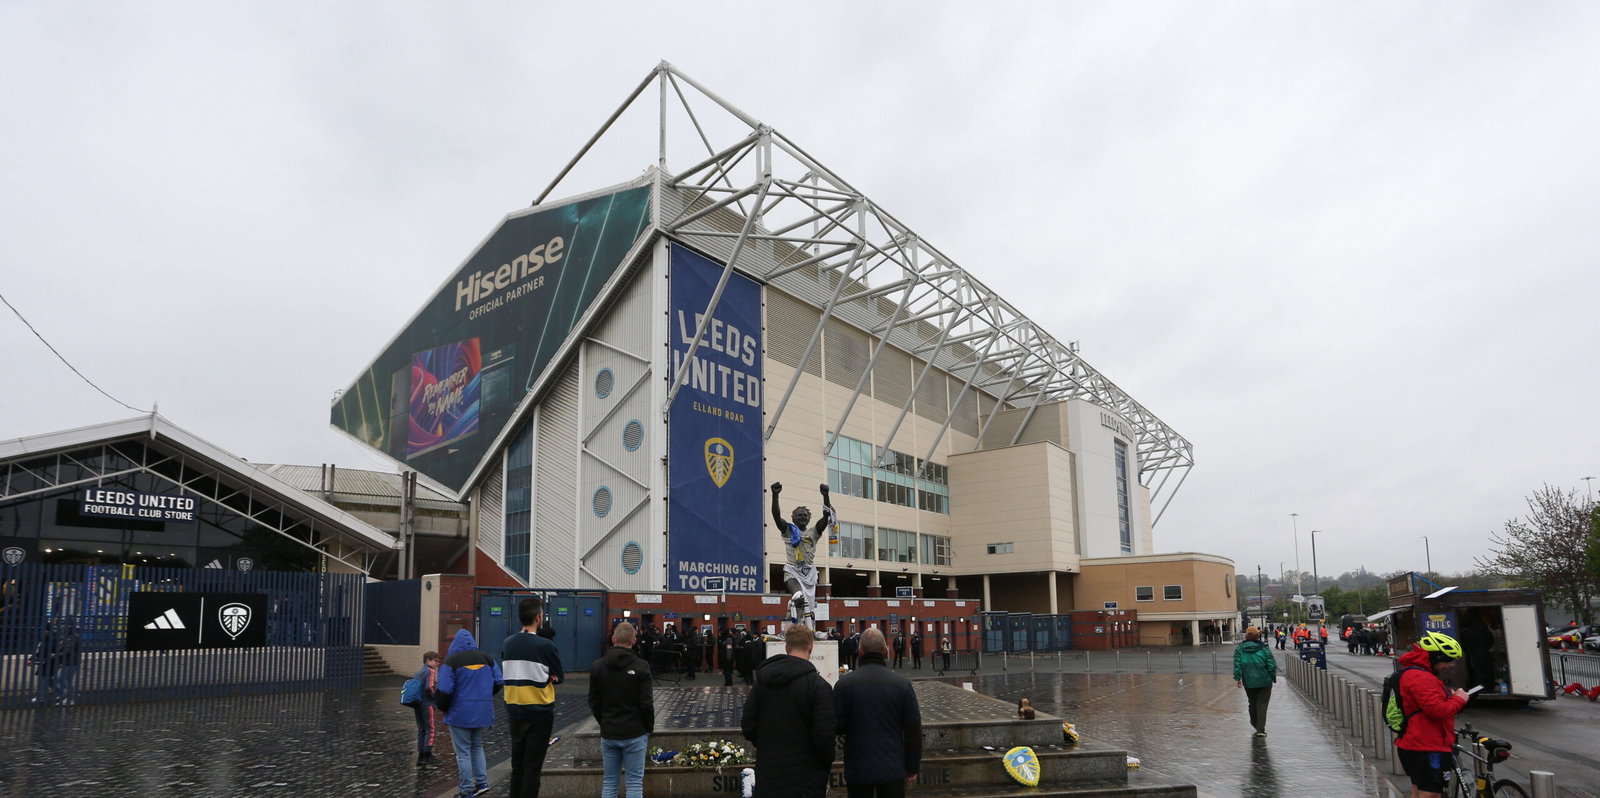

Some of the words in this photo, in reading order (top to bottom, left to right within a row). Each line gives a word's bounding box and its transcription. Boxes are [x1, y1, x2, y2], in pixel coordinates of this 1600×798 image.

[455, 236, 564, 312] Hisense
[469, 296, 504, 320] OFFICIAL
[506, 276, 544, 303] PARTNER
[677, 309, 756, 367] LEEDS
[673, 349, 760, 408] UNITED
[693, 401, 722, 417] ELLAND
[724, 410, 744, 423] ROAD
[85, 489, 136, 506] LEEDS
[139, 494, 194, 511] UNITED
[84, 504, 135, 517] FOOTBALL
[138, 508, 162, 518] CLUB
[164, 510, 193, 520] STORE
[679, 561, 739, 575] MARCHING
[742, 565, 757, 575] ON
[679, 574, 757, 591] TOTHER
[713, 775, 742, 792] SID
